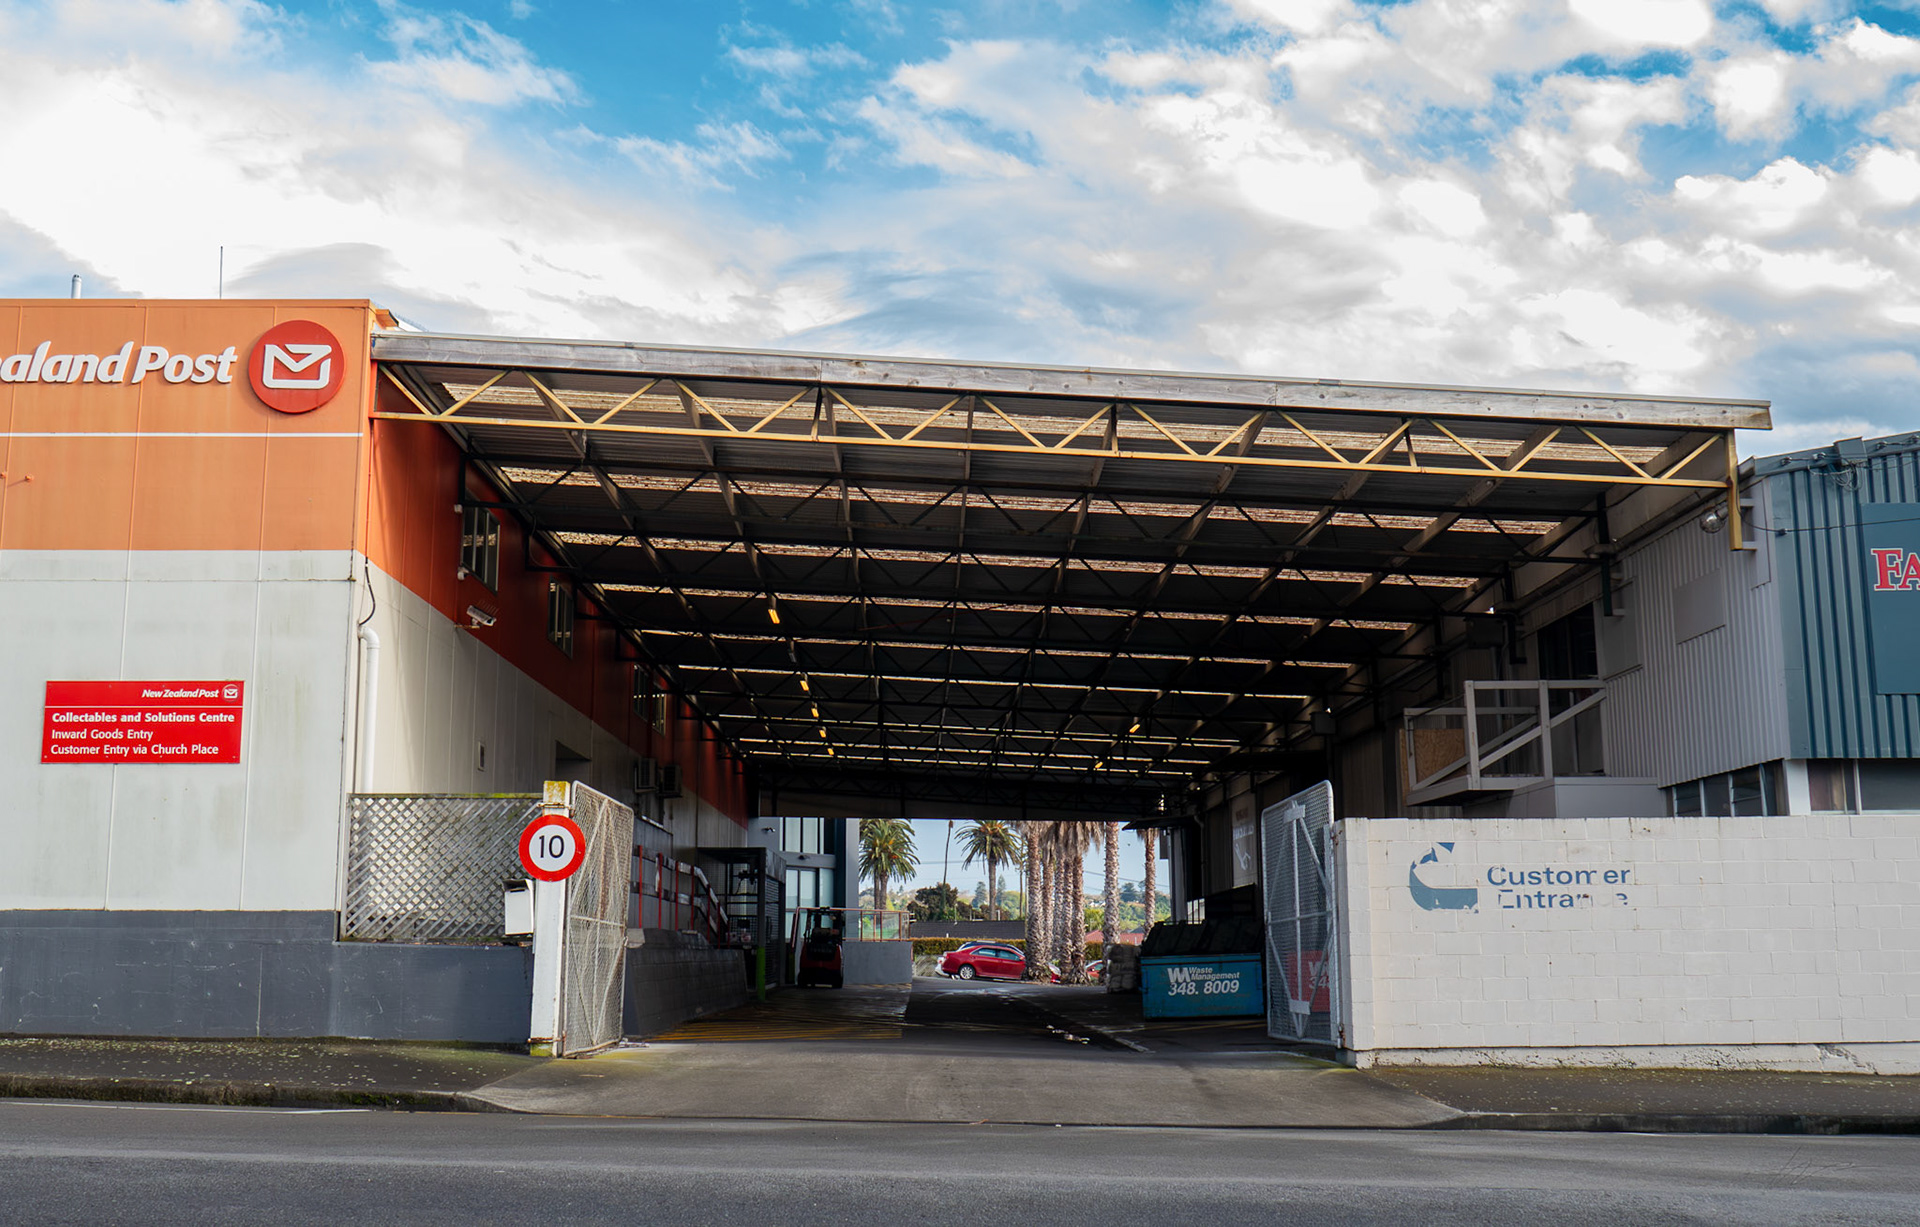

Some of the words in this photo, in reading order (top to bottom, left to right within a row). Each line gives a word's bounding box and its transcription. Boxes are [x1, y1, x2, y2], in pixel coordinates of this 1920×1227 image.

[0, 340, 134, 383] aland
[132, 346, 237, 383] Post
[142, 689, 164, 698] New
[163, 689, 199, 698] Zealand
[199, 689, 219, 698] Post
[52, 712, 117, 723] Collectables
[120, 712, 141, 723] and
[145, 712, 195, 723] Solutions
[199, 712, 235, 722] Centre
[51, 729, 87, 739] Inward
[90, 729, 124, 739] Goods
[127, 729, 153, 741] Entry
[50, 744, 100, 754] Customer
[103, 744, 130, 757] Entry
[132, 744, 148, 754] via
[151, 744, 188, 754] Church
[191, 744, 219, 754] Place
[538, 834, 565, 859] 10
[1487, 866, 1631, 886] Customer
[1190, 972, 1240, 981] Management
[1203, 980, 1240, 994] 8009
